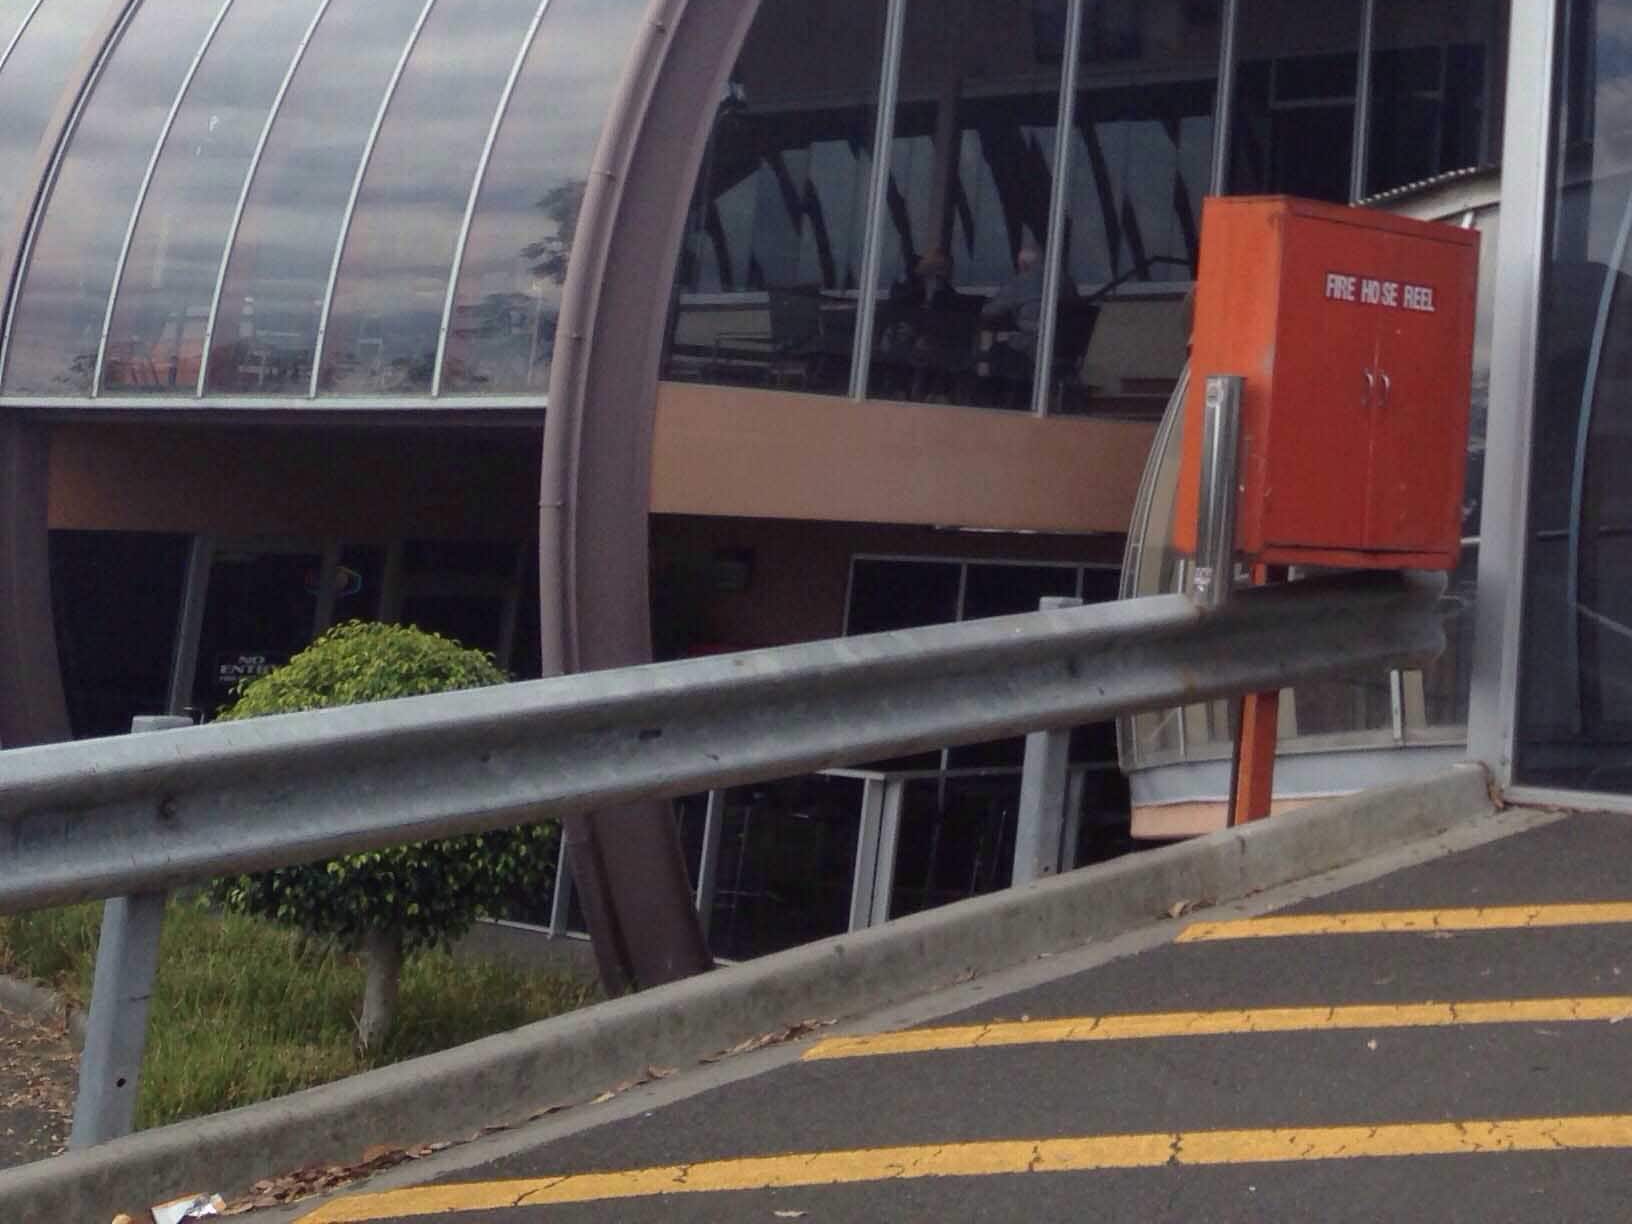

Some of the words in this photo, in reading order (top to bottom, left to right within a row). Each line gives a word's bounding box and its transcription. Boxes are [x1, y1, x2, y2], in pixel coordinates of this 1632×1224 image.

[1326, 273, 1357, 301] FIRE
[1361, 279, 1399, 307] HOSE
[1403, 285, 1436, 312] REEL
[239, 656, 265, 665] NO
